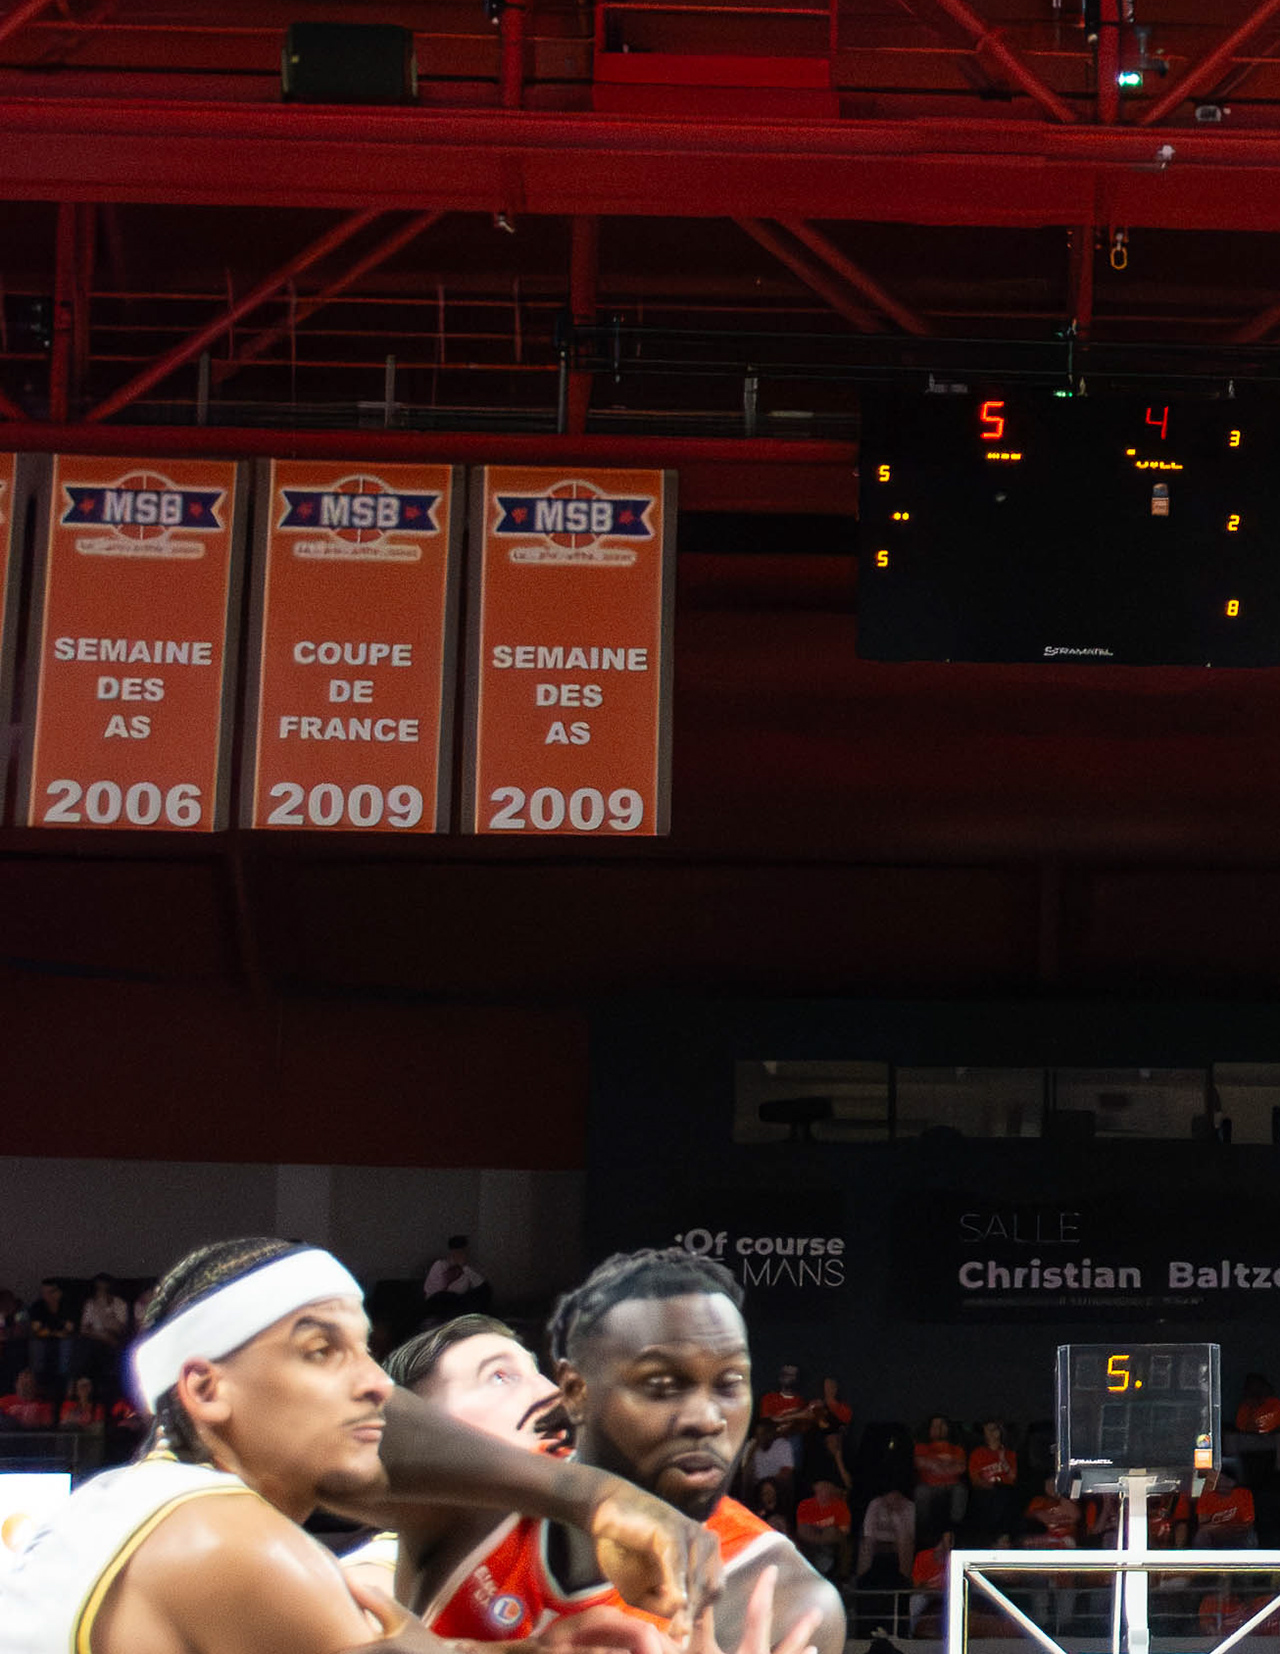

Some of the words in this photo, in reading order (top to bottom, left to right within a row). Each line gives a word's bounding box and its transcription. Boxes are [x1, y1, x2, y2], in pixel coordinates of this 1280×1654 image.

[979, 401, 1005, 439] 5
[1144, 405, 1170, 440] 4
[1228, 429, 1241, 447] 3
[878, 465, 890, 482] 5
[103, 491, 182, 525] MSB
[320, 495, 400, 528] MSB
[534, 500, 614, 533] MSB
[1227, 514, 1240, 532] 2
[876, 550, 889, 567] 5
[1226, 600, 1239, 617] 8
[54, 637, 213, 666] SEMAINE
[294, 642, 412, 667] COUPE
[492, 645, 648, 671] SEMAINE
[97, 677, 165, 702] DES
[329, 680, 373, 703] DE
[536, 684, 604, 708] DES
[104, 715, 152, 739] AS
[279, 716, 419, 742] FRANCE
[544, 721, 590, 745] AS
[43, 780, 202, 828] 2006
[267, 782, 424, 828] 2009
[489, 786, 644, 831] 2009
[959, 1212, 1082, 1245] SALLE
[736, 1233, 844, 1256] course
[744, 1259, 845, 1286] MANS
[958, 1260, 1142, 1289] Christian
